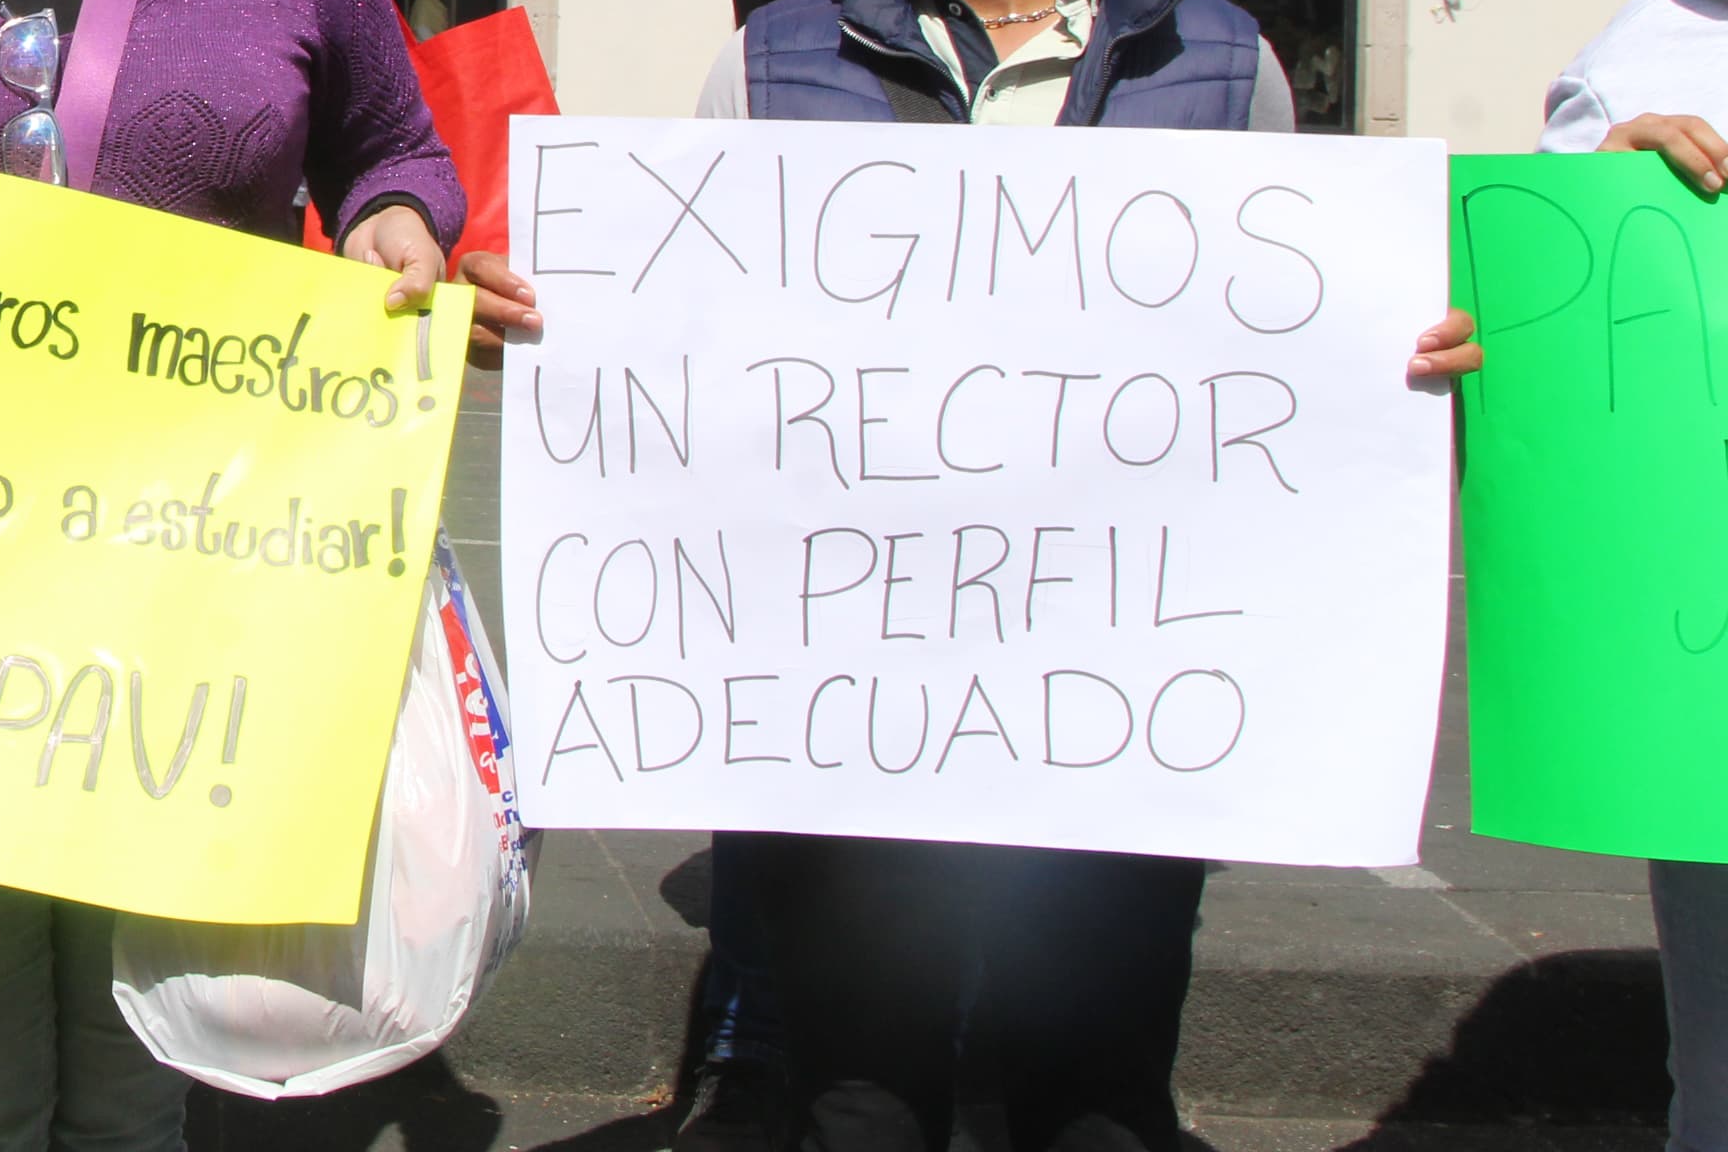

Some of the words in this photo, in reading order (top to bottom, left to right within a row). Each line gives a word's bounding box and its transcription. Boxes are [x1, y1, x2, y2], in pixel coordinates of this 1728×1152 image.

[531, 141, 1325, 336] EXIGIMOS
[1462, 183, 1718, 416] PA
[534, 354, 692, 479] UN
[746, 357, 1301, 495] RECTOR
[60, 484, 98, 543] a
[535, 530, 736, 664] CON
[798, 523, 1246, 648] PERFIL
[542, 667, 1247, 788] ADECUADO
